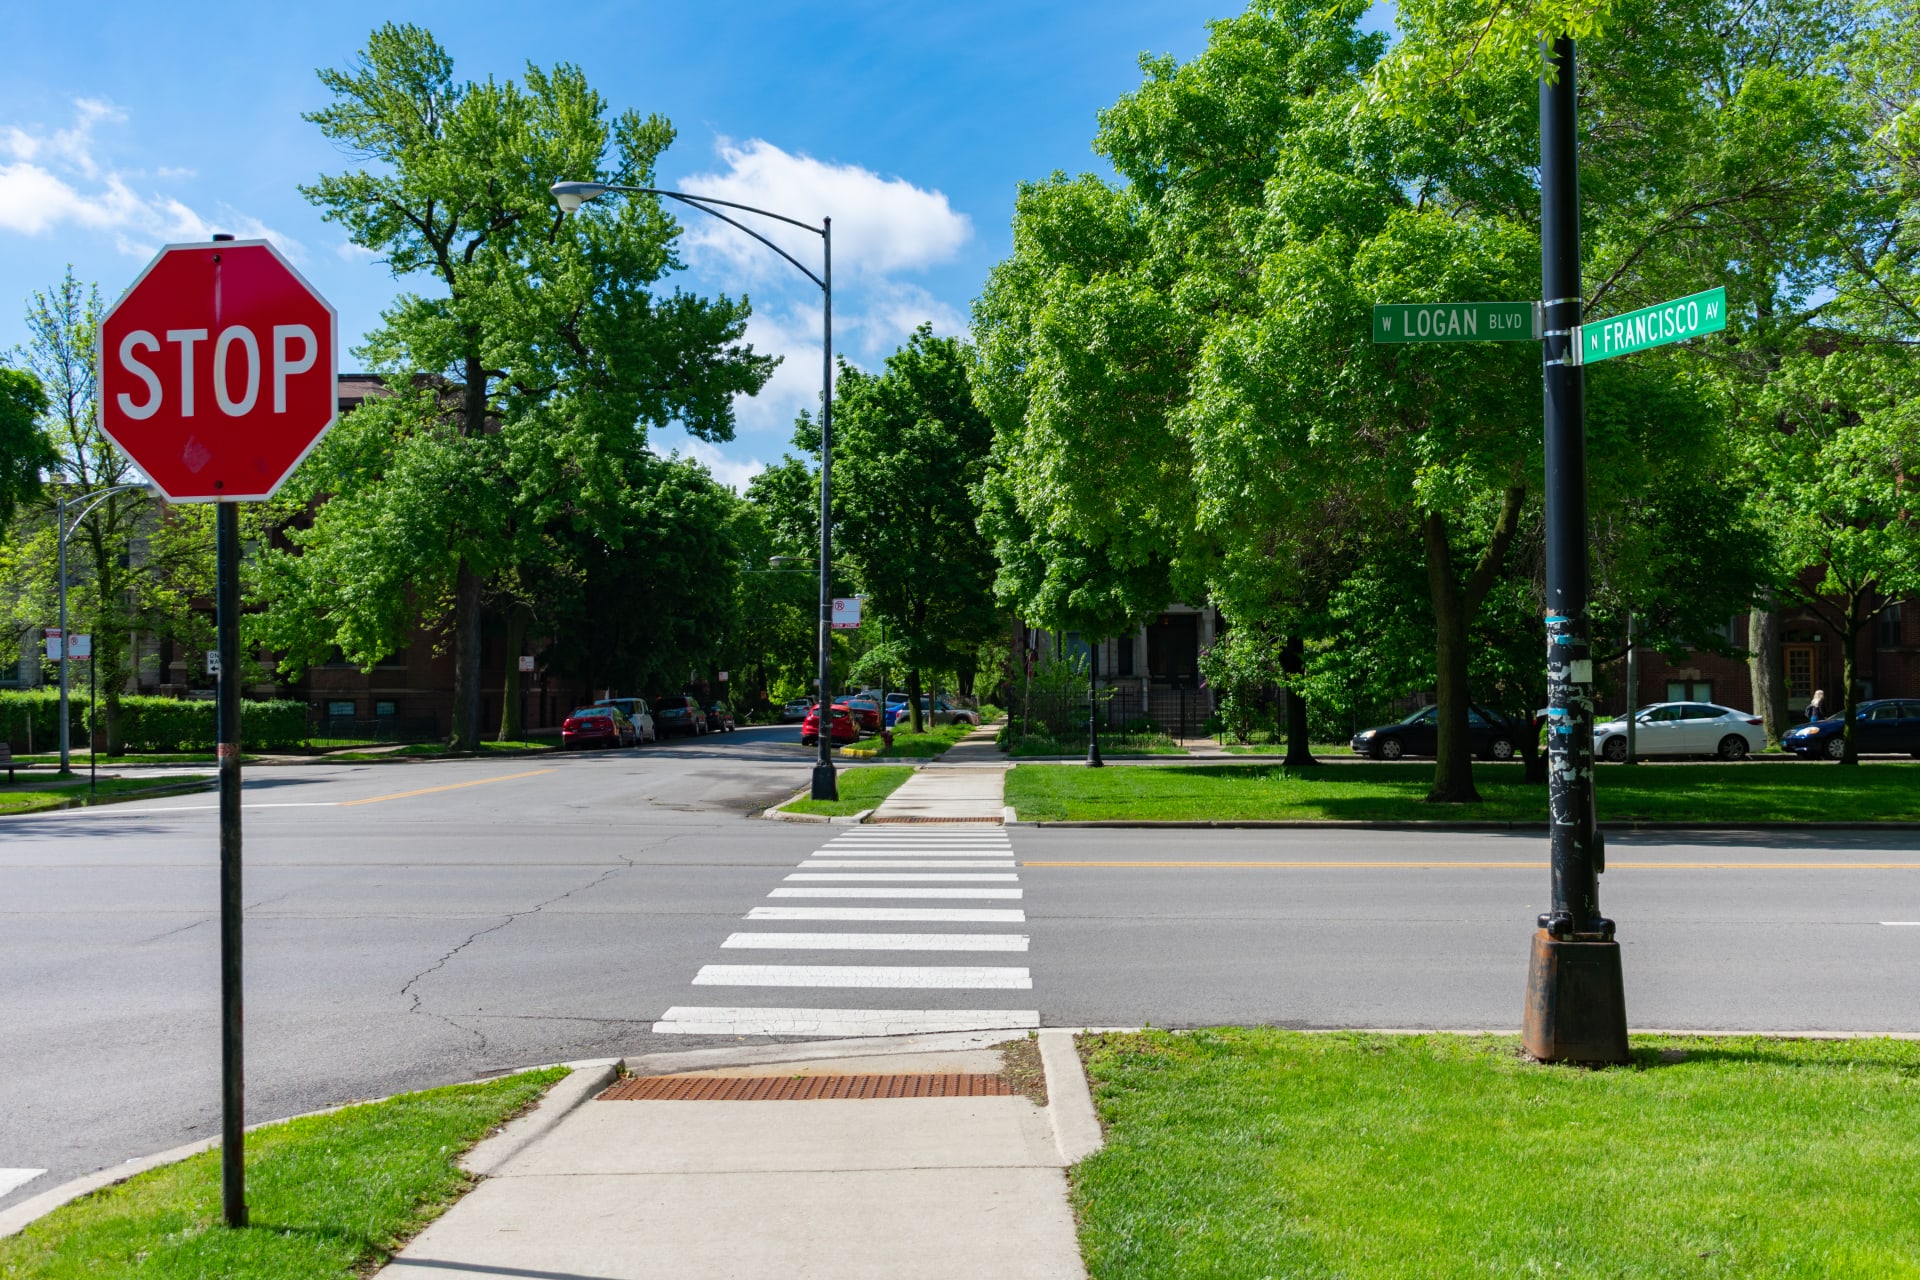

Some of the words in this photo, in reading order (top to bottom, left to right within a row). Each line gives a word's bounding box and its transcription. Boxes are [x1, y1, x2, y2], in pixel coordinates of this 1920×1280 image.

[1382, 316, 1392, 332] W
[1403, 308, 1477, 337] LOGAN
[1489, 313, 1522, 329] BLVD
[1591, 333, 1598, 350] N
[1604, 301, 1698, 353] FRANCISCO
[1705, 301, 1719, 320] AV
[117, 324, 318, 420] STOP
